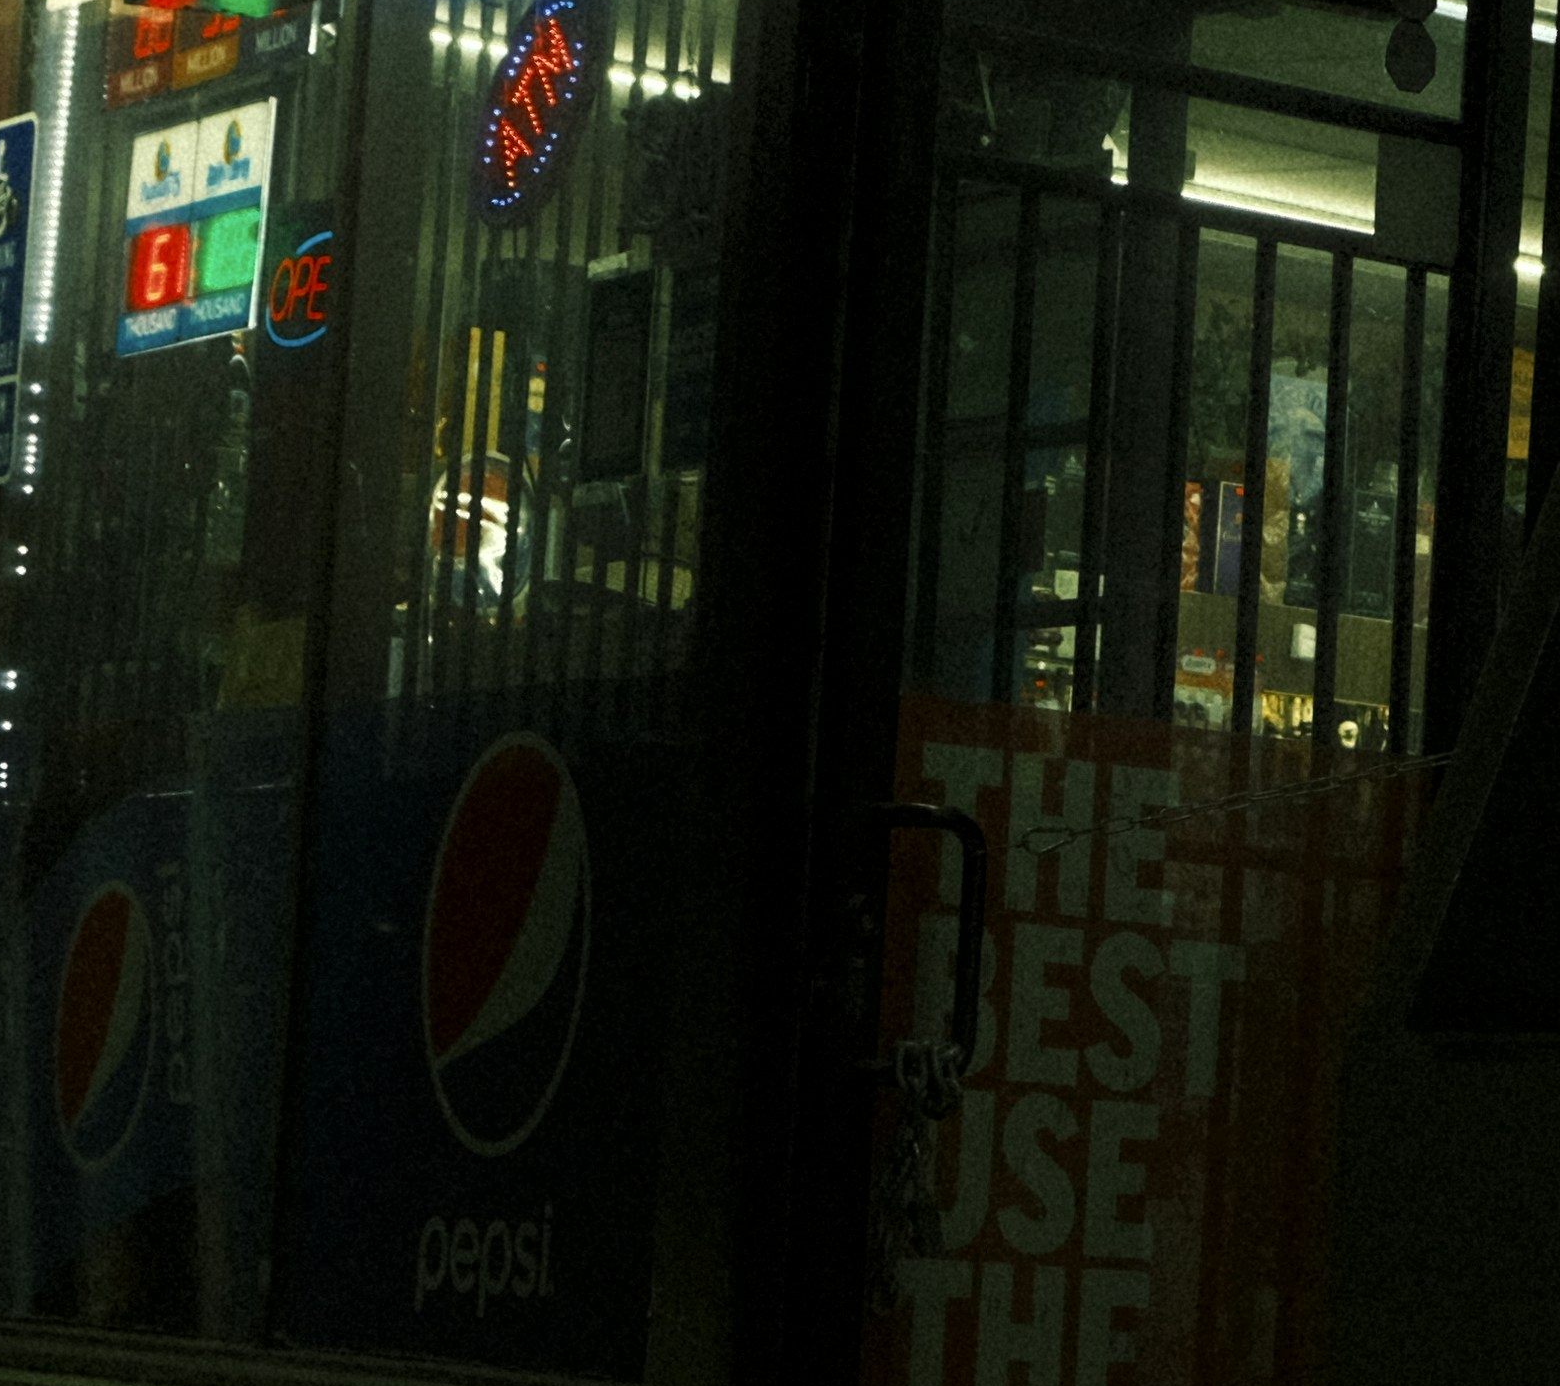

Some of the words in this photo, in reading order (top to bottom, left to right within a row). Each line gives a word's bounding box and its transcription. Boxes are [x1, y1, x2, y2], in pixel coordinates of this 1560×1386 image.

[499, 15, 574, 190] ATM
[268, 254, 333, 323] OPE
[921, 739, 1181, 928] THE
[911, 909, 1248, 1099] BEST
[414, 1199, 556, 1315] pepsi
[929, 1087, 1164, 1263] USE
